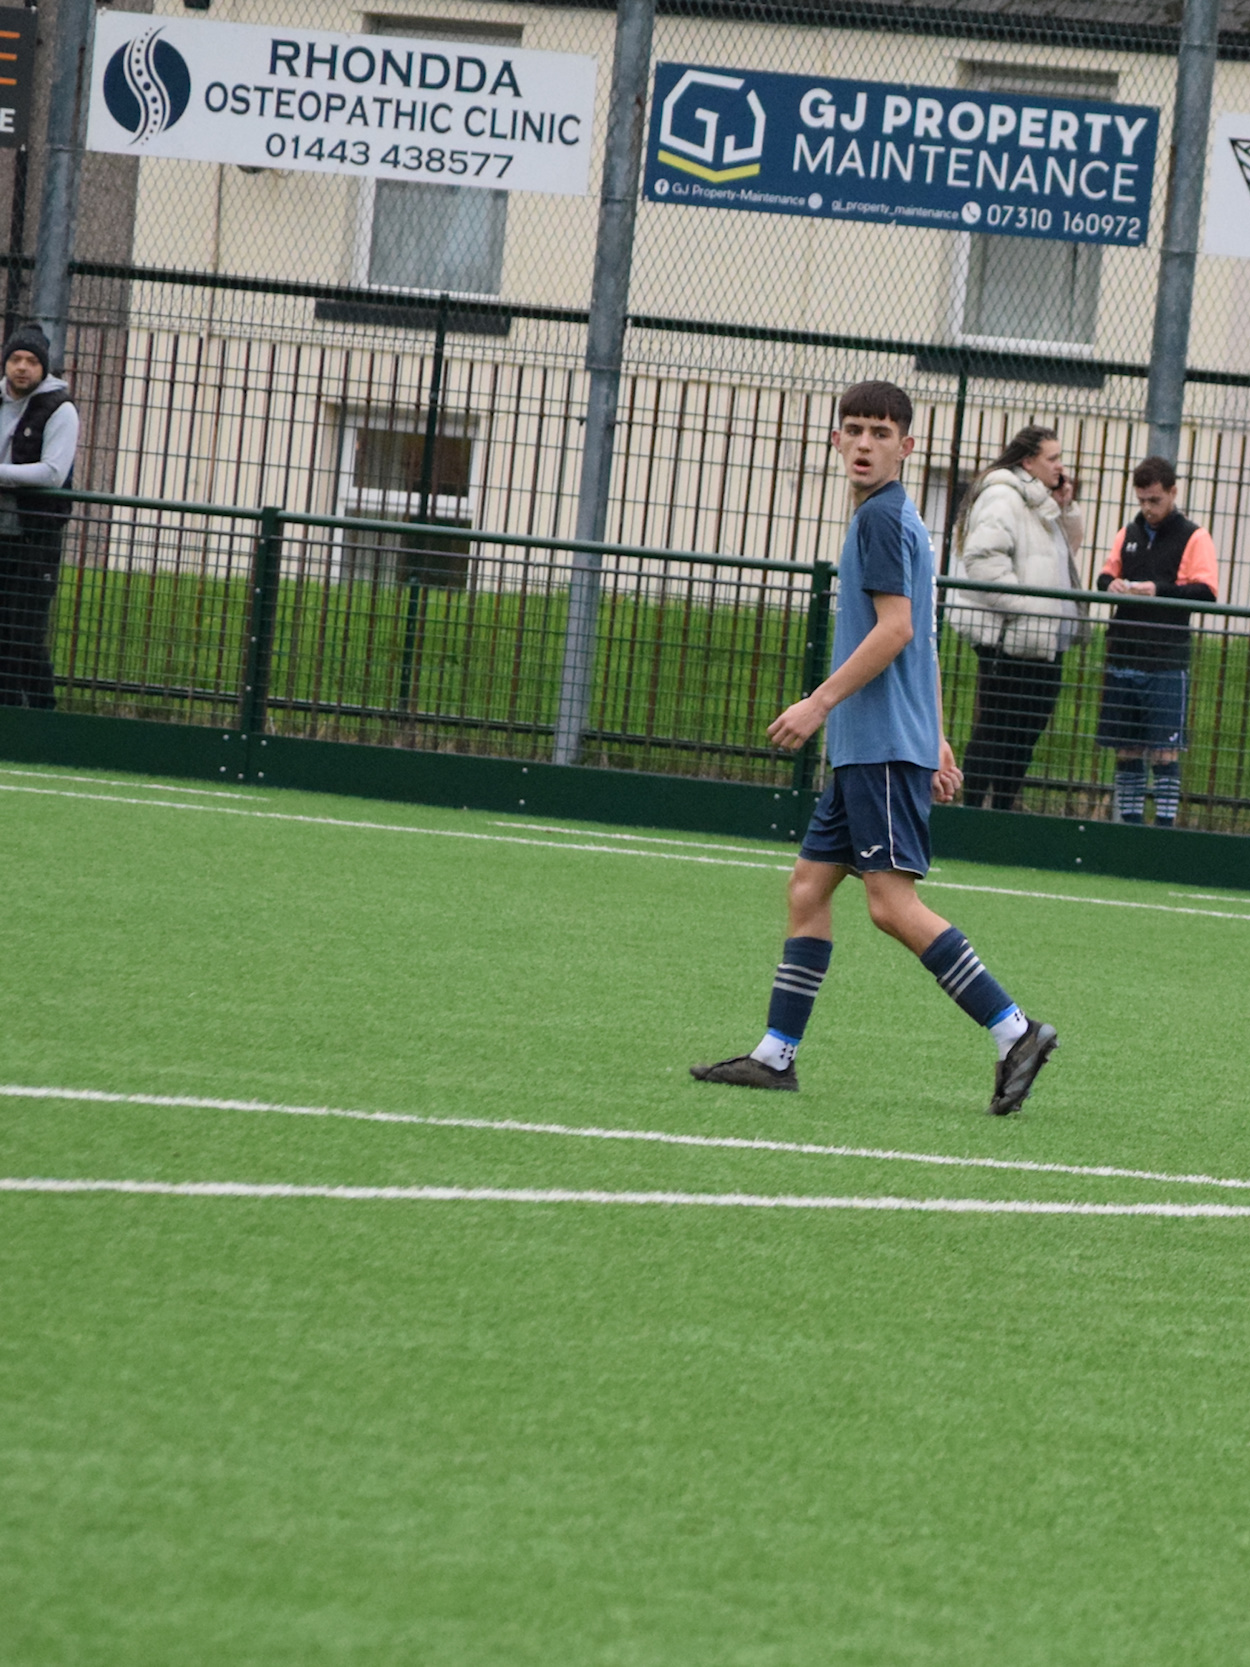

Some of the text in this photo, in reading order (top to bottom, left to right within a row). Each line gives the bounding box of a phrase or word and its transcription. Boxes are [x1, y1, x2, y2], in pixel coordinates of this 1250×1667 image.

[268, 39, 523, 98] RHONDDA
[205, 82, 581, 146] OSTEOPATHIC CLINIC
[800, 88, 1148, 157] GJ PROPERTY
[265, 134, 514, 178] 01443 438577
[792, 133, 1139, 203] MAINTENANCE
[672, 182, 806, 206] GJ Property-Maintenance
[986, 203, 1141, 240] 07310 160972
